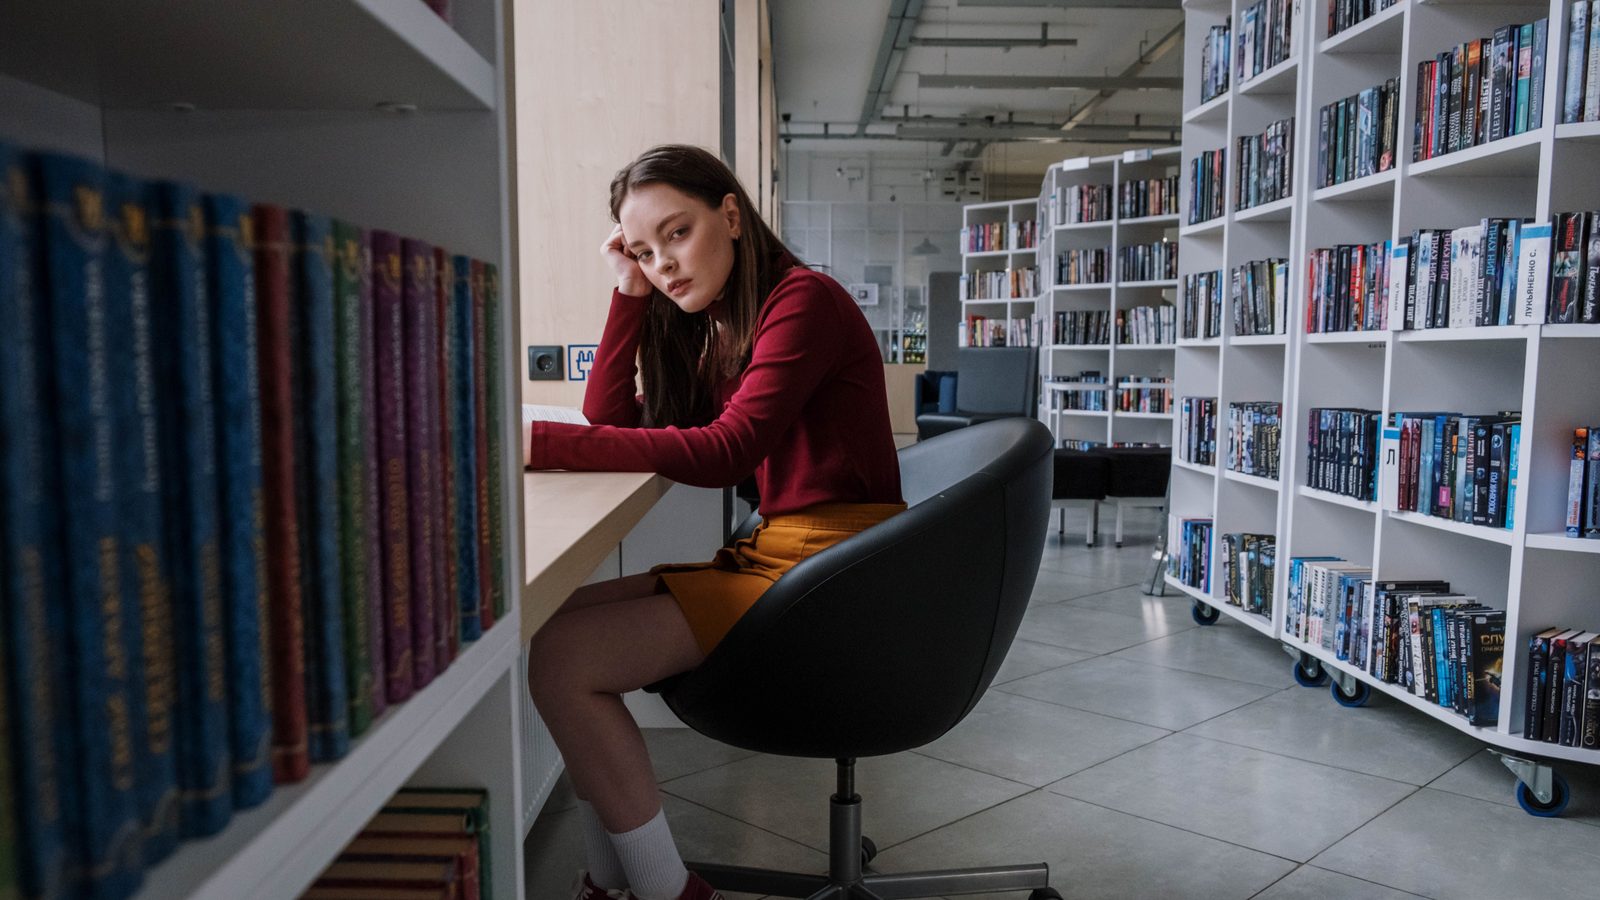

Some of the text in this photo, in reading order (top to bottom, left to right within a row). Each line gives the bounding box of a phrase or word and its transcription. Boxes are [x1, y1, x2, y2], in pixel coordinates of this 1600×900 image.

[1492, 88, 1502, 137] ЦЕРБЕР
[1431, 235, 1439, 259] КУНЦ
[1441, 233, 1451, 280] ДИН КУНЦ
[1486, 225, 1497, 275] ДИН КУНЦ
[1429, 262, 1437, 282] ДИН
[1525, 249, 1537, 318] ЛУКЬЯНЕНКО С.
[1477, 278, 1485, 299] КУНЦ
[1386, 448, 1396, 465] Л
[1490, 471, 1498, 483] РОЗ
[1488, 484, 1497, 514] ЛЮБОВНИК
